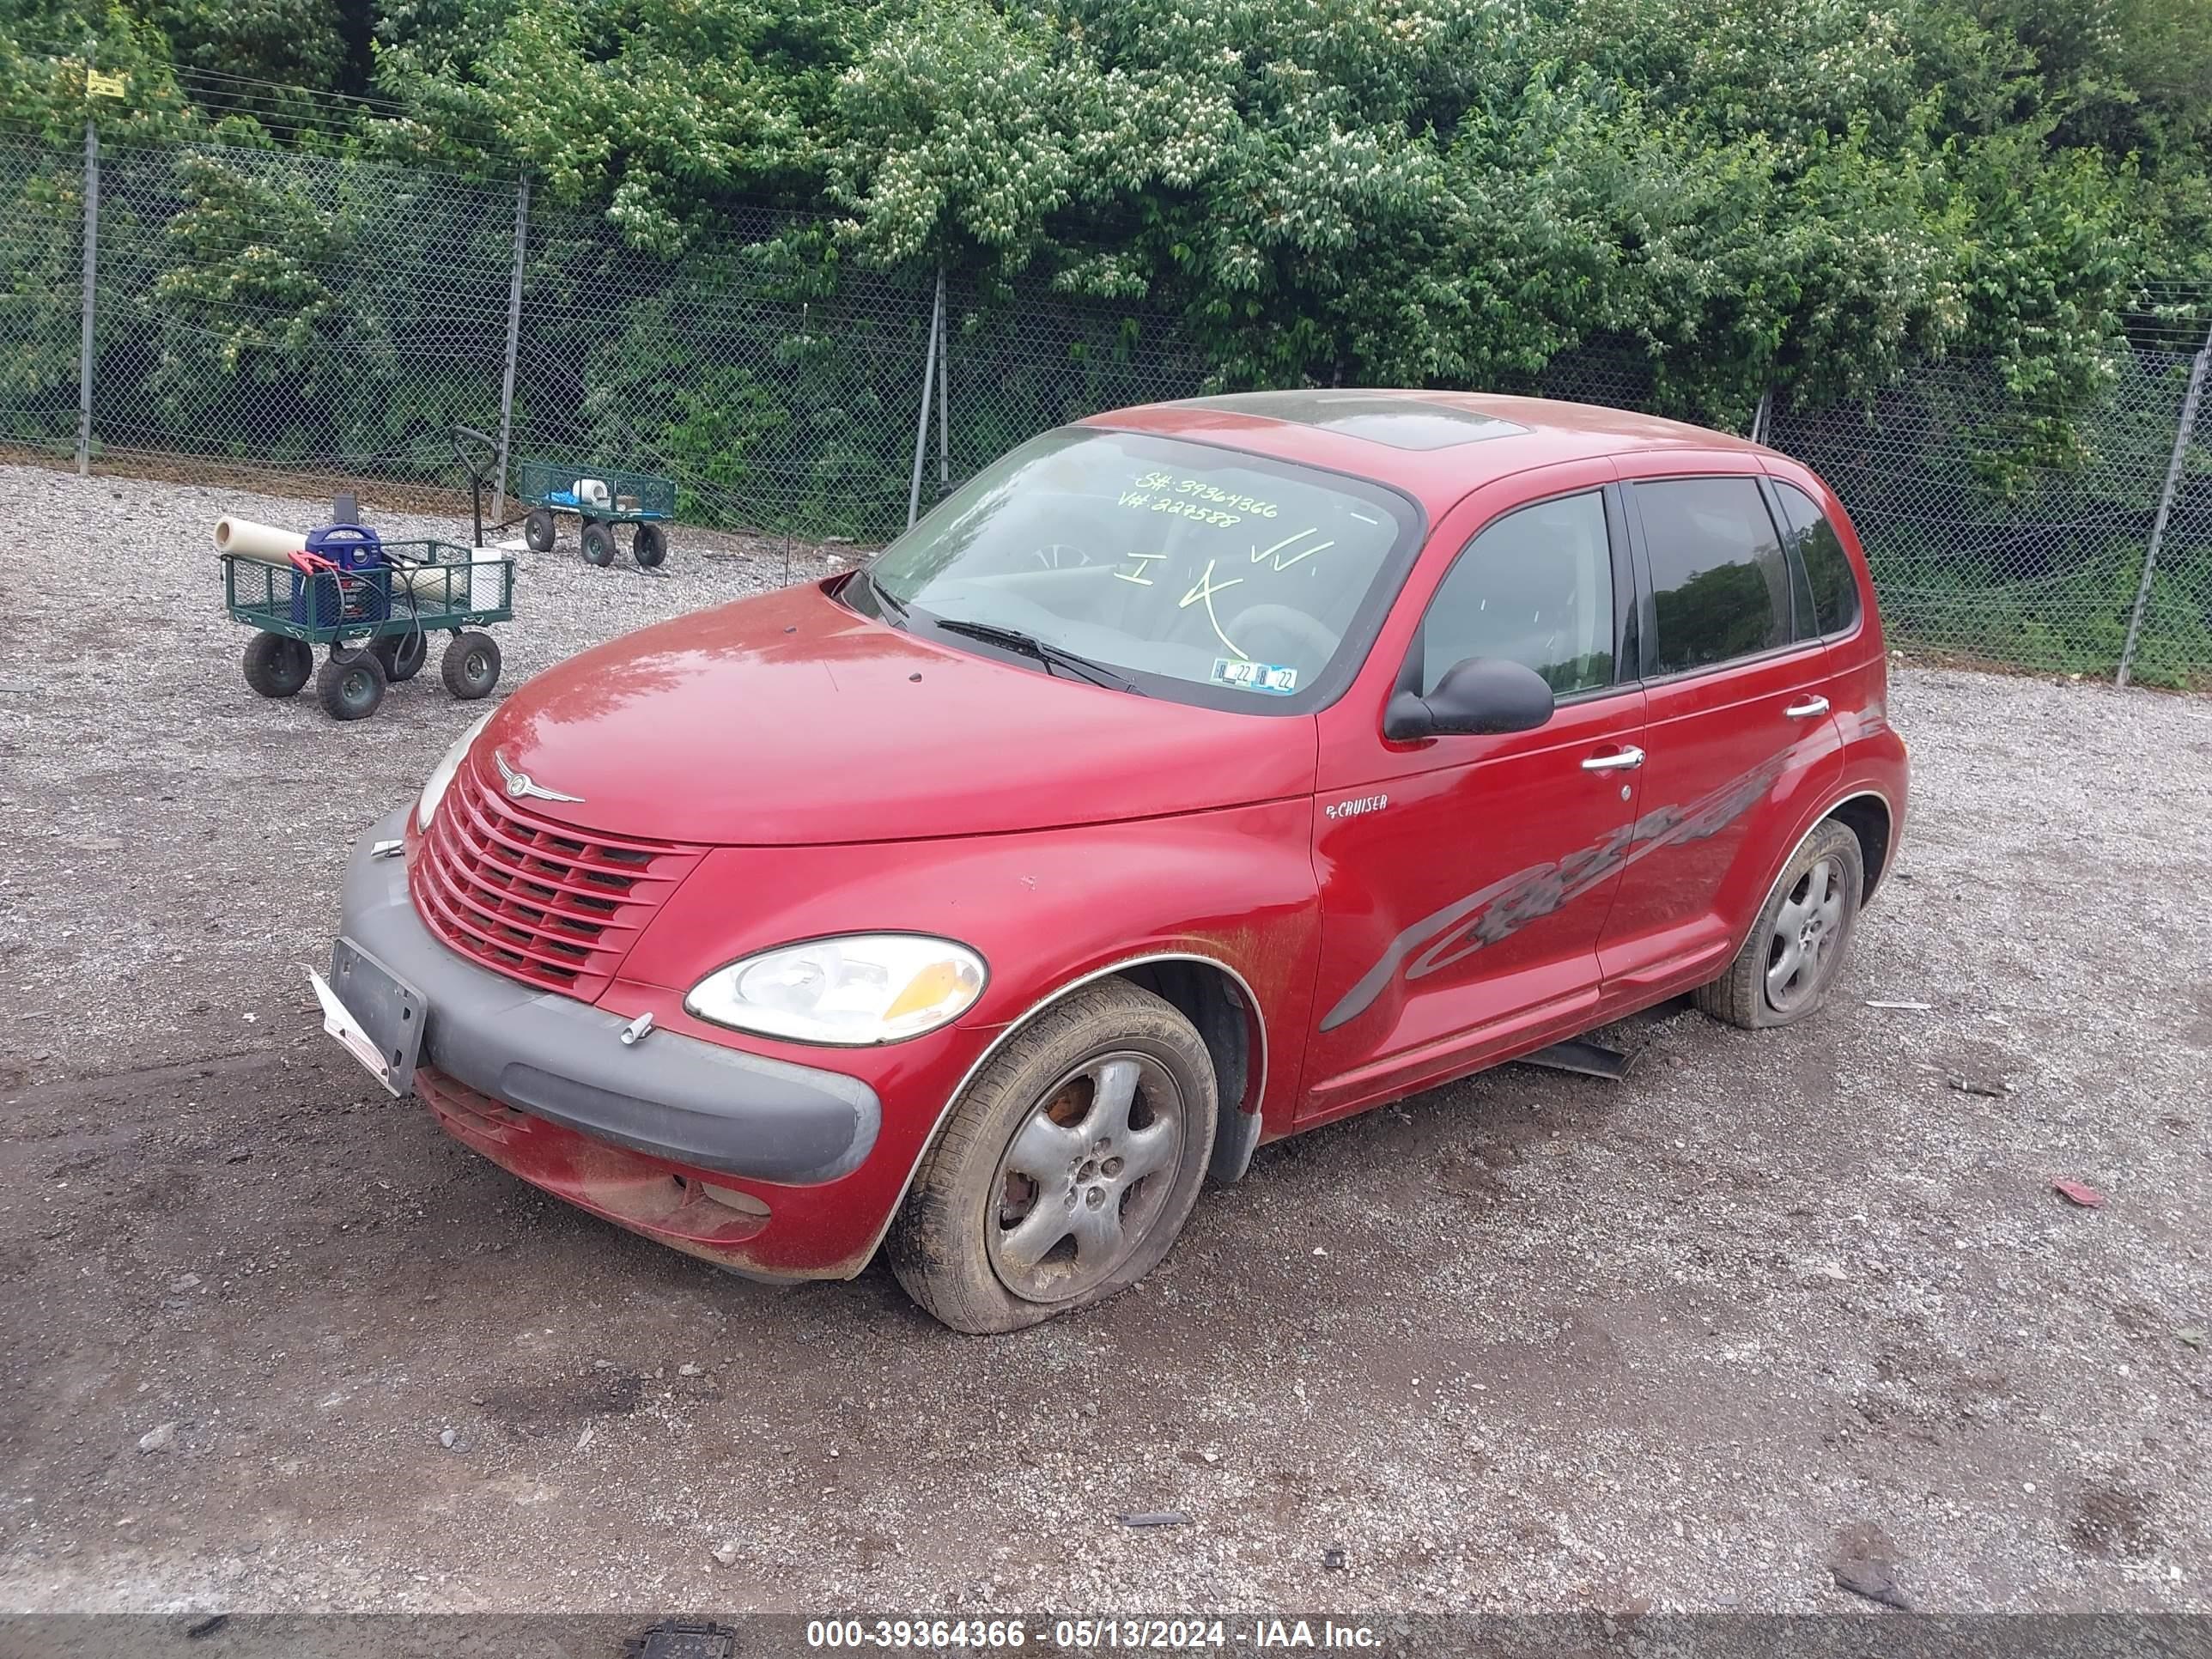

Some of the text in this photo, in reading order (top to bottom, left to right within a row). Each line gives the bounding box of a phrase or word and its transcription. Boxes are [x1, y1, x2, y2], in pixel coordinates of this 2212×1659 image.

[1176, 480, 1278, 518] 39364366
[1151, 498, 1242, 528] 227588
[1237, 665, 1251, 682] 22
[1278, 671, 1292, 689] 22
[1338, 794, 1389, 817] CRUISER
